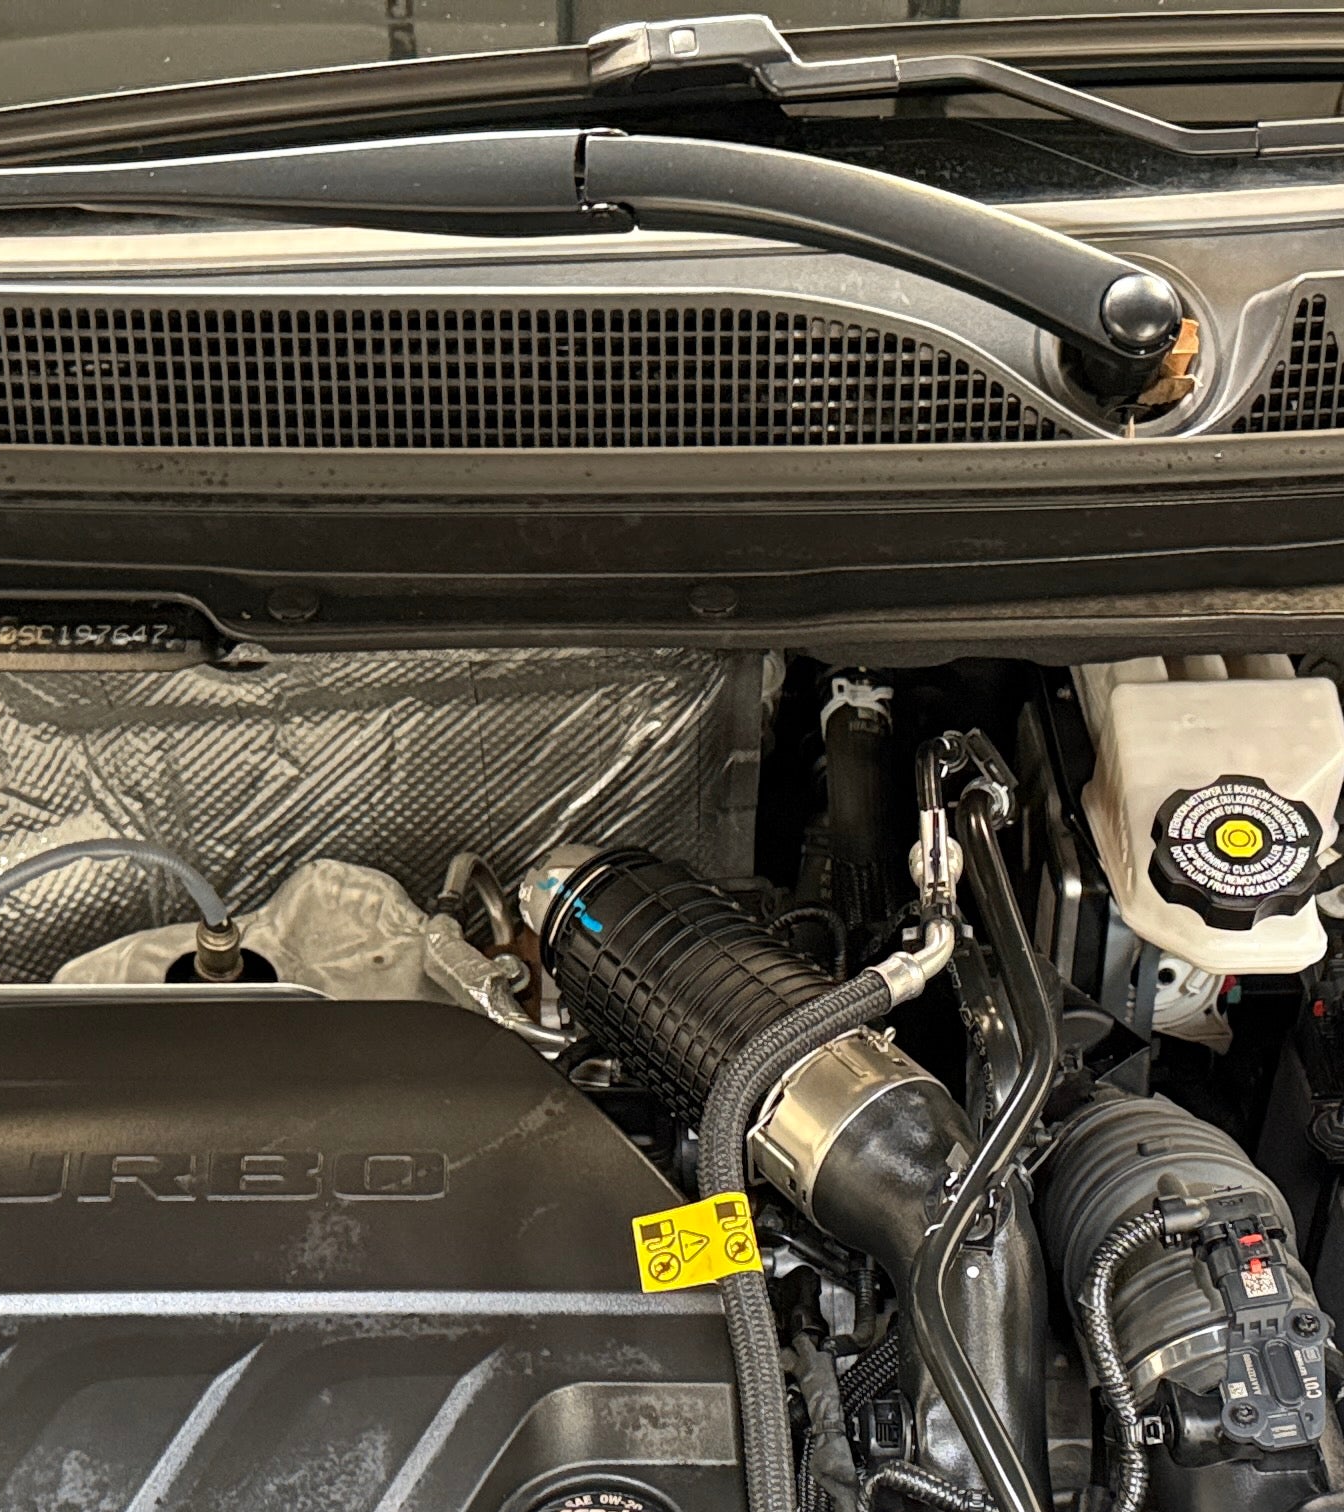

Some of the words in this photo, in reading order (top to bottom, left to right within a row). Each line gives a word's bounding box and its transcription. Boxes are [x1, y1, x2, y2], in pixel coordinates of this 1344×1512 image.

[1232, 861, 1264, 875] CLEAN
[1206, 879, 1236, 896] FROM
[1235, 886, 1244, 897] A
[564, 1494, 593, 1509] SAE
